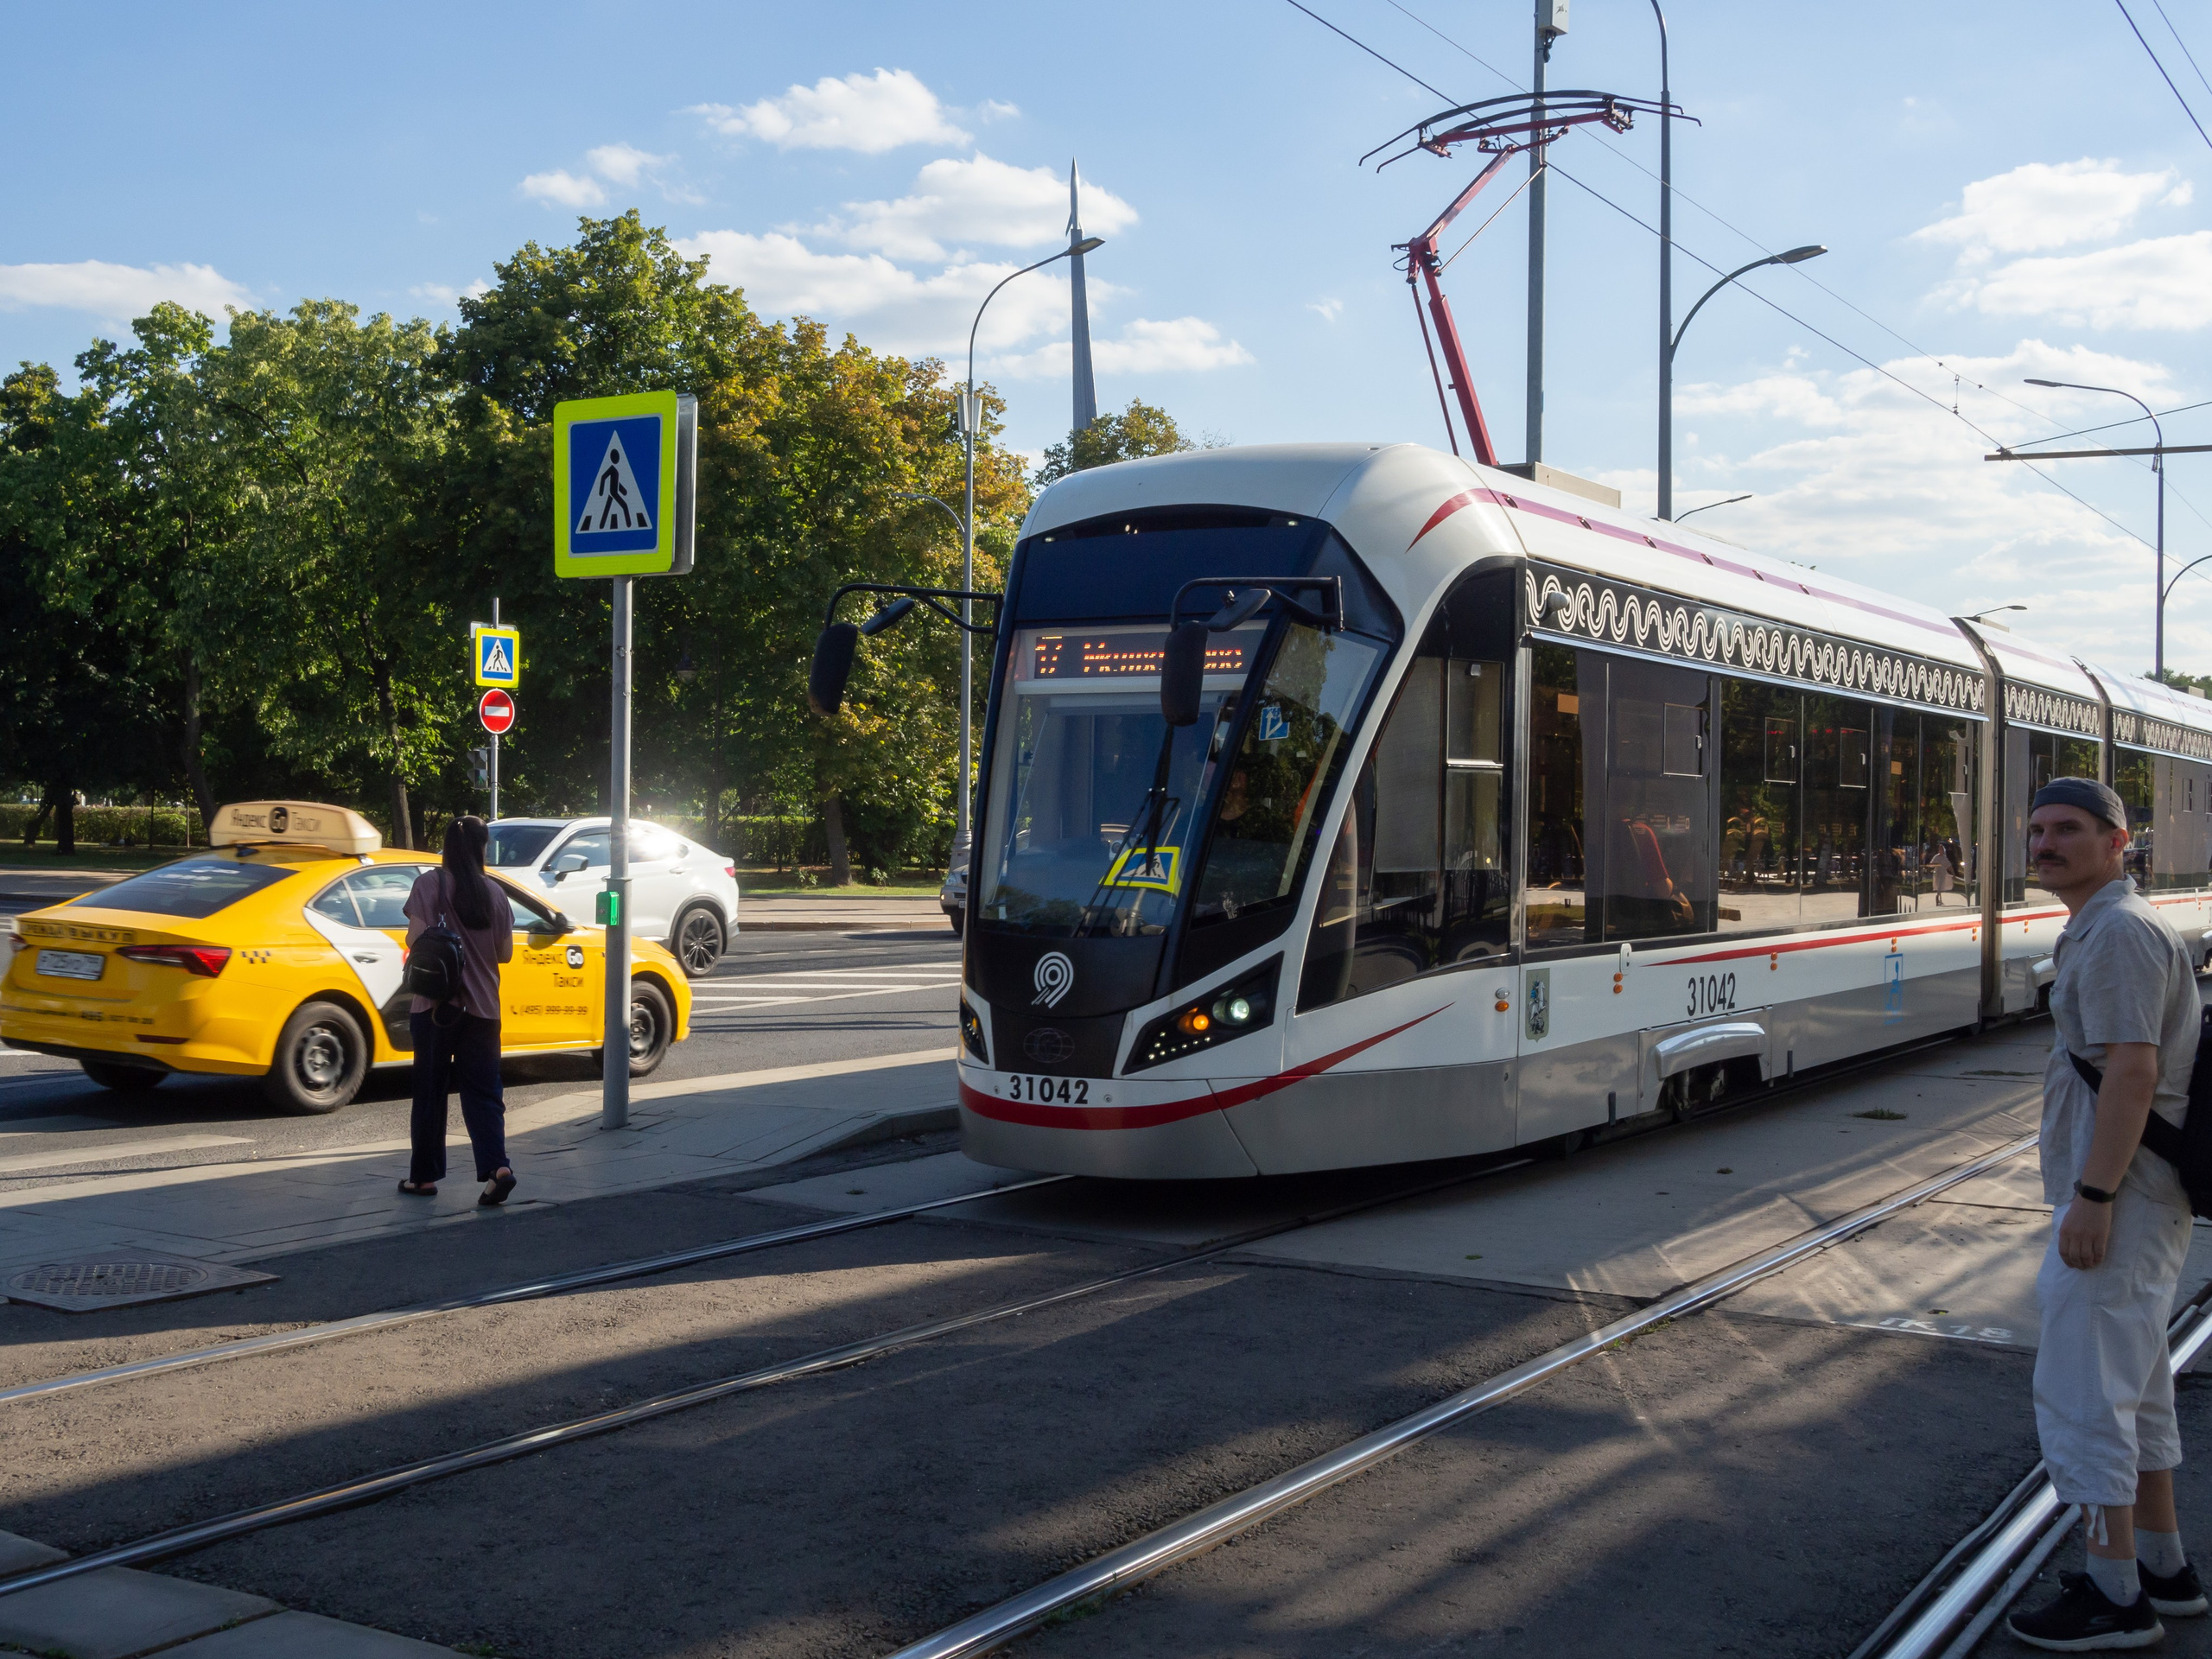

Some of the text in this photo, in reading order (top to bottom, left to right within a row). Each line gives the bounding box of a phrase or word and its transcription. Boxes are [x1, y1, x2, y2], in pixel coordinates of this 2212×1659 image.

[230, 809, 267, 829] Яндекс
[522, 948, 585, 966] Яндекс Go
[552, 972, 584, 988] Такси
[1686, 972, 1737, 1016] 31042
[1009, 1075, 1090, 1104] 31042
